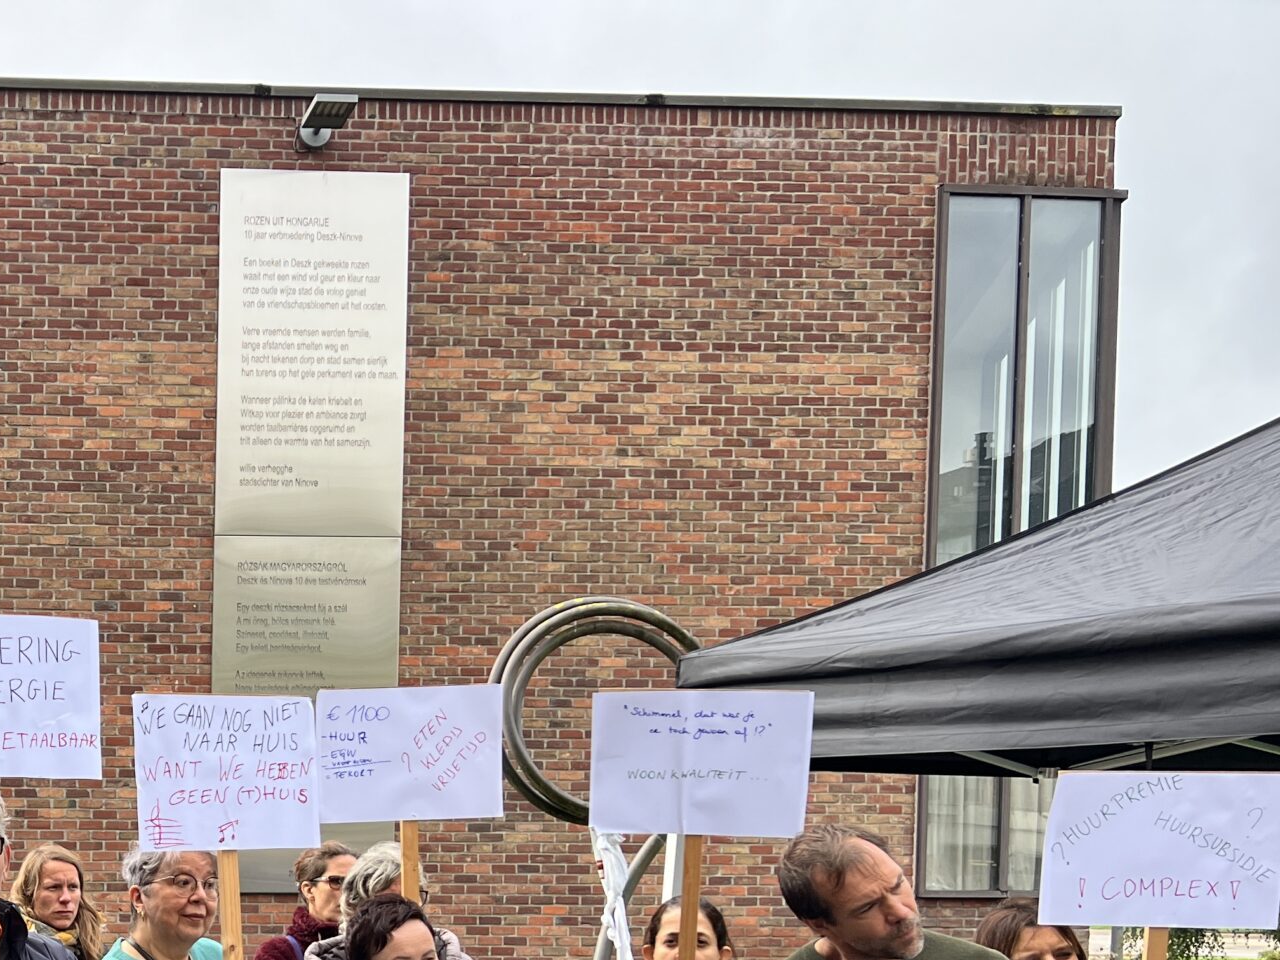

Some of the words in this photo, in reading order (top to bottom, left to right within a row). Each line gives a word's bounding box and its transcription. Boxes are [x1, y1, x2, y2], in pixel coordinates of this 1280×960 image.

[244, 216, 270, 225] ROZEN
[272, 216, 284, 226] UIT
[286, 217, 329, 227] HONGARIJE
[244, 230, 252, 239] 10
[254, 230, 267, 241] jaar
[269, 230, 314, 243] verbroedering
[317, 231, 363, 242] Deszk-Ninove
[243, 257, 257, 267] Een
[259, 258, 281, 267] boeket
[283, 258, 289, 267] in
[291, 258, 311, 268] Deszk
[314, 259, 349, 270] gekweekte
[351, 261, 369, 269] rozen
[243, 271, 261, 281] waait
[277, 273, 289, 281] een
[291, 272, 307, 282] wind
[309, 272, 318, 282] vol
[320, 274, 335, 284] geur
[337, 274, 345, 283] en
[347, 274, 363, 283] kleur
[365, 275, 380, 283] naar
[243, 287, 259, 295] onze
[261, 286, 277, 295] oude
[279, 286, 296, 297] wijze
[298, 286, 312, 296] stad
[314, 287, 324, 296] die
[346, 287, 366, 298] geniet
[243, 300, 255, 308] van
[256, 299, 265, 309] de
[351, 301, 361, 310] het
[242, 326, 260, 336] Verre
[262, 328, 291, 337] vreemde
[293, 329, 319, 337] mensen
[242, 341, 260, 352] lange
[262, 341, 295, 351] afstanden
[296, 342, 323, 351] smelten
[324, 344, 338, 353] weg
[251, 355, 269, 364] nacht
[271, 355, 298, 364] tekenen
[300, 355, 314, 366] dorp
[317, 357, 325, 365] en
[327, 355, 341, 365] stad
[242, 368, 254, 377] hun
[256, 369, 277, 378] torens
[279, 371, 287, 379] op
[289, 369, 299, 378] het
[301, 369, 315, 380] gele
[317, 370, 352, 380] perkament
[368, 370, 376, 379] de
[241, 395, 271, 405] Wanneer
[298, 396, 307, 405] de
[265, 411, 280, 419] voor
[282, 410, 304, 421] plezier
[316, 410, 348, 420] ambiance
[240, 423, 265, 432] worden
[309, 424, 345, 434] opgeruimd
[252, 437, 272, 446] alleen
[274, 437, 282, 446] de
[284, 438, 308, 447] warmte
[310, 439, 322, 447] van
[324, 438, 335, 447] het
[239, 477, 279, 487] stadsdichter
[281, 479, 293, 487] van
[295, 478, 318, 487] Ninove
[237, 576, 258, 585] Deszk
[294, 577, 303, 585] 10
[237, 603, 250, 614] Egy
[137, 706, 166, 735] WE
[173, 703, 215, 729] GAAN
[221, 708, 251, 732] NOG
[264, 702, 300, 731] NIET
[347, 705, 390, 723] 1100
[413, 707, 448, 749] ETEN
[183, 732, 238, 752] NAAR
[254, 733, 298, 753] HUIS
[329, 731, 367, 744] HUUR
[421, 726, 463, 770] KLEDIJ
[432, 731, 487, 792] VRIJETIJD
[143, 756, 202, 782] WANT
[219, 755, 244, 782] WE
[170, 786, 229, 805] GEEN
[237, 786, 308, 805] (T)HUIS
[1063, 774, 1184, 845] HUURPREMIE
[1154, 811, 1276, 883] HUURSUBSIDIE
[1102, 877, 1219, 900] COMPLEX
